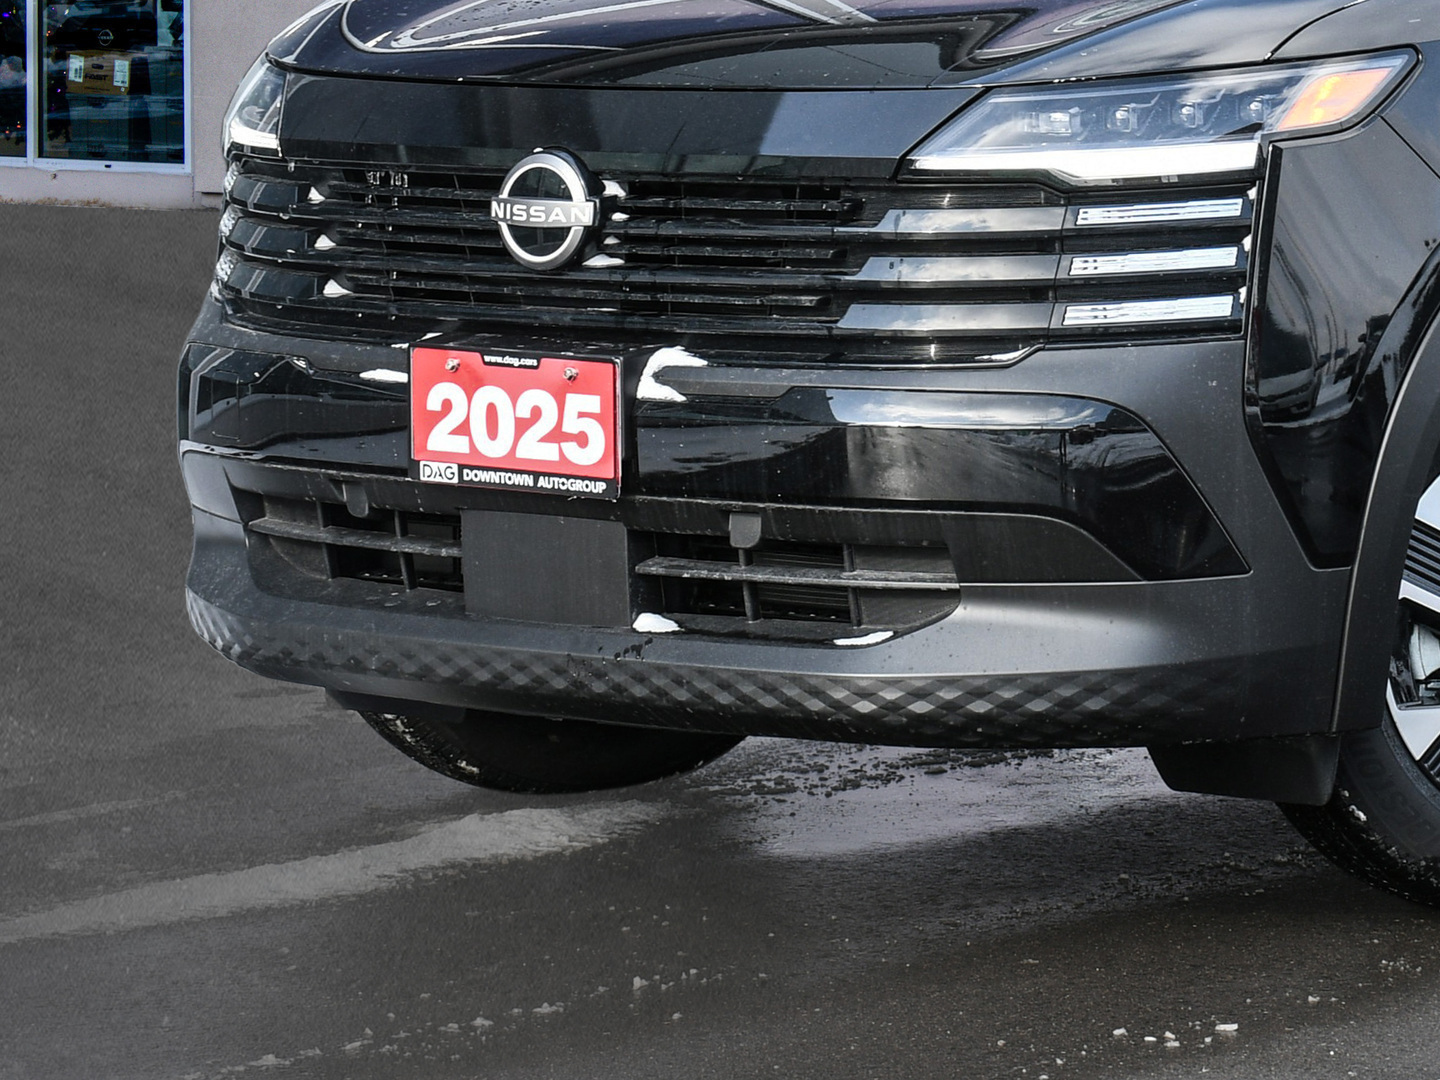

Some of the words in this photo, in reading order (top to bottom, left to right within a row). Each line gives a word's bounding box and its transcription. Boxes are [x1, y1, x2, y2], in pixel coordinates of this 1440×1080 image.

[491, 201, 590, 223] NISSAN
[426, 381, 606, 466] 2025
[422, 463, 456, 480] DAG
[463, 469, 534, 487] DOWNTOWN
[537, 475, 607, 494] AUTOGROUP
